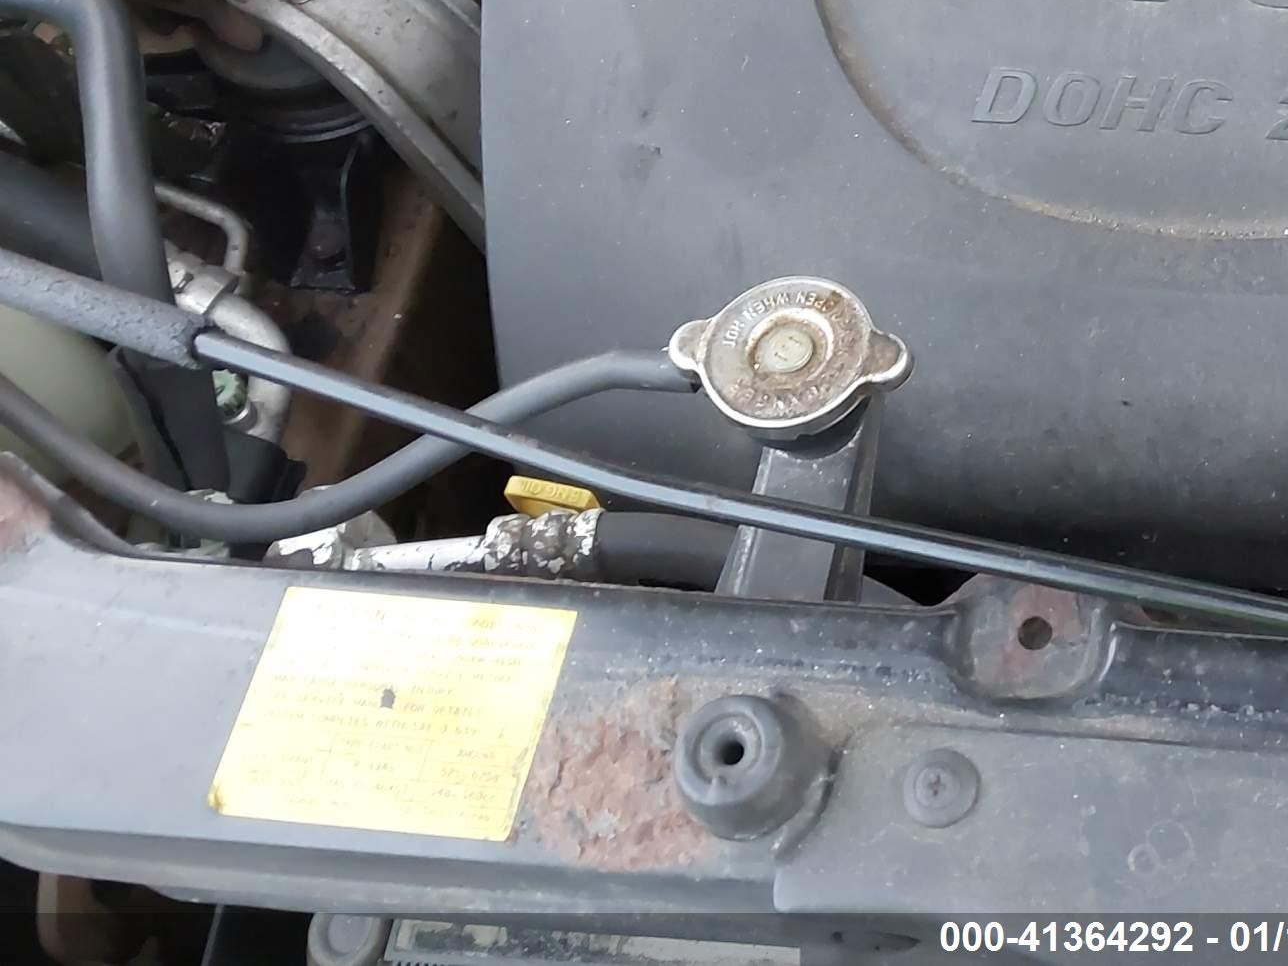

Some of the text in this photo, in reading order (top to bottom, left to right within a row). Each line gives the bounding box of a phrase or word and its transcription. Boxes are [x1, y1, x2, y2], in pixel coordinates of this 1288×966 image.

[970, 66, 1234, 135] DOHC
[742, 291, 789, 321] WHEN
[721, 318, 745, 348] HOT
